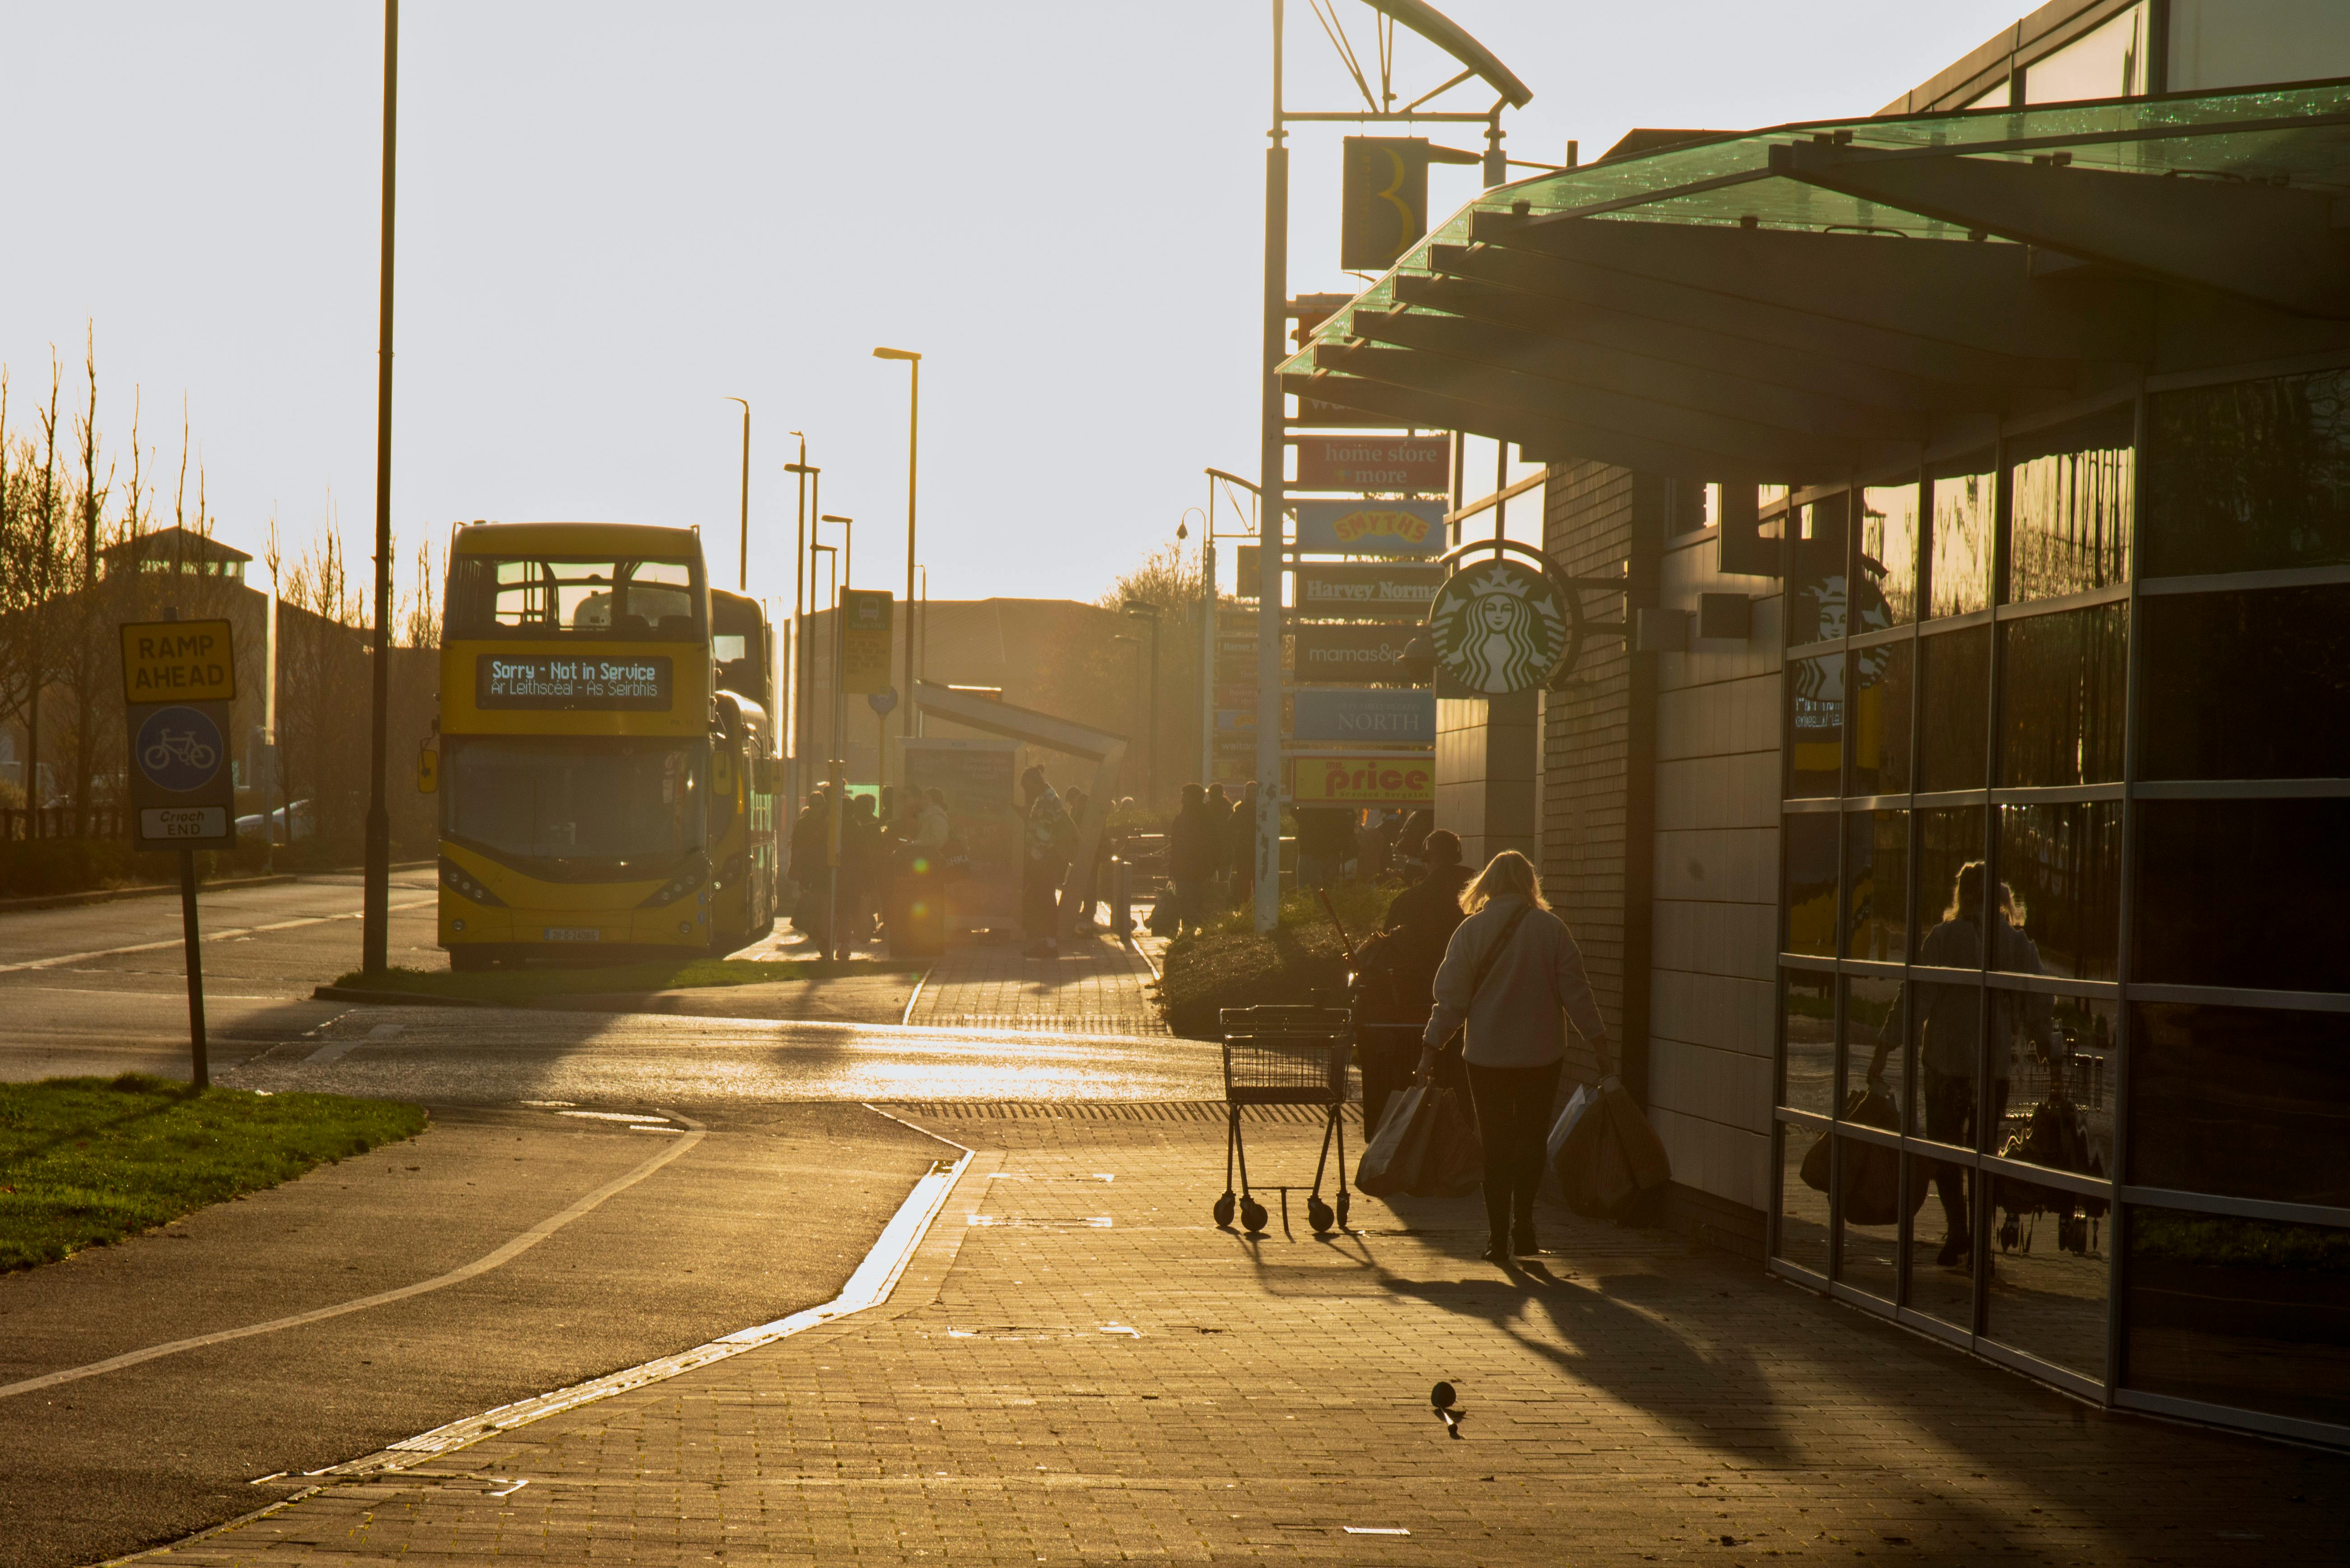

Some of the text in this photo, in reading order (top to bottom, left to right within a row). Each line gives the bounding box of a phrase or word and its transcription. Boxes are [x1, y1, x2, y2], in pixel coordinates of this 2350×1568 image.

[1325, 443, 1437, 463] home store
[1355, 470, 1407, 483] more
[1336, 513, 1427, 541] SMYTHS
[1307, 580, 1440, 601] Harvey Norma
[140, 635, 214, 659] RAMP
[1309, 643, 1403, 665] mamas&p
[135, 664, 224, 689] AHEAD
[493, 661, 534, 679] Sorry
[550, 661, 578, 679] Not
[583, 662, 595, 680] in
[600, 662, 655, 680] Service
[1338, 713, 1420, 731] NORTH
[1325, 761, 1345, 769] MR.
[1325, 761, 1430, 797] price
[168, 823, 201, 836] END
